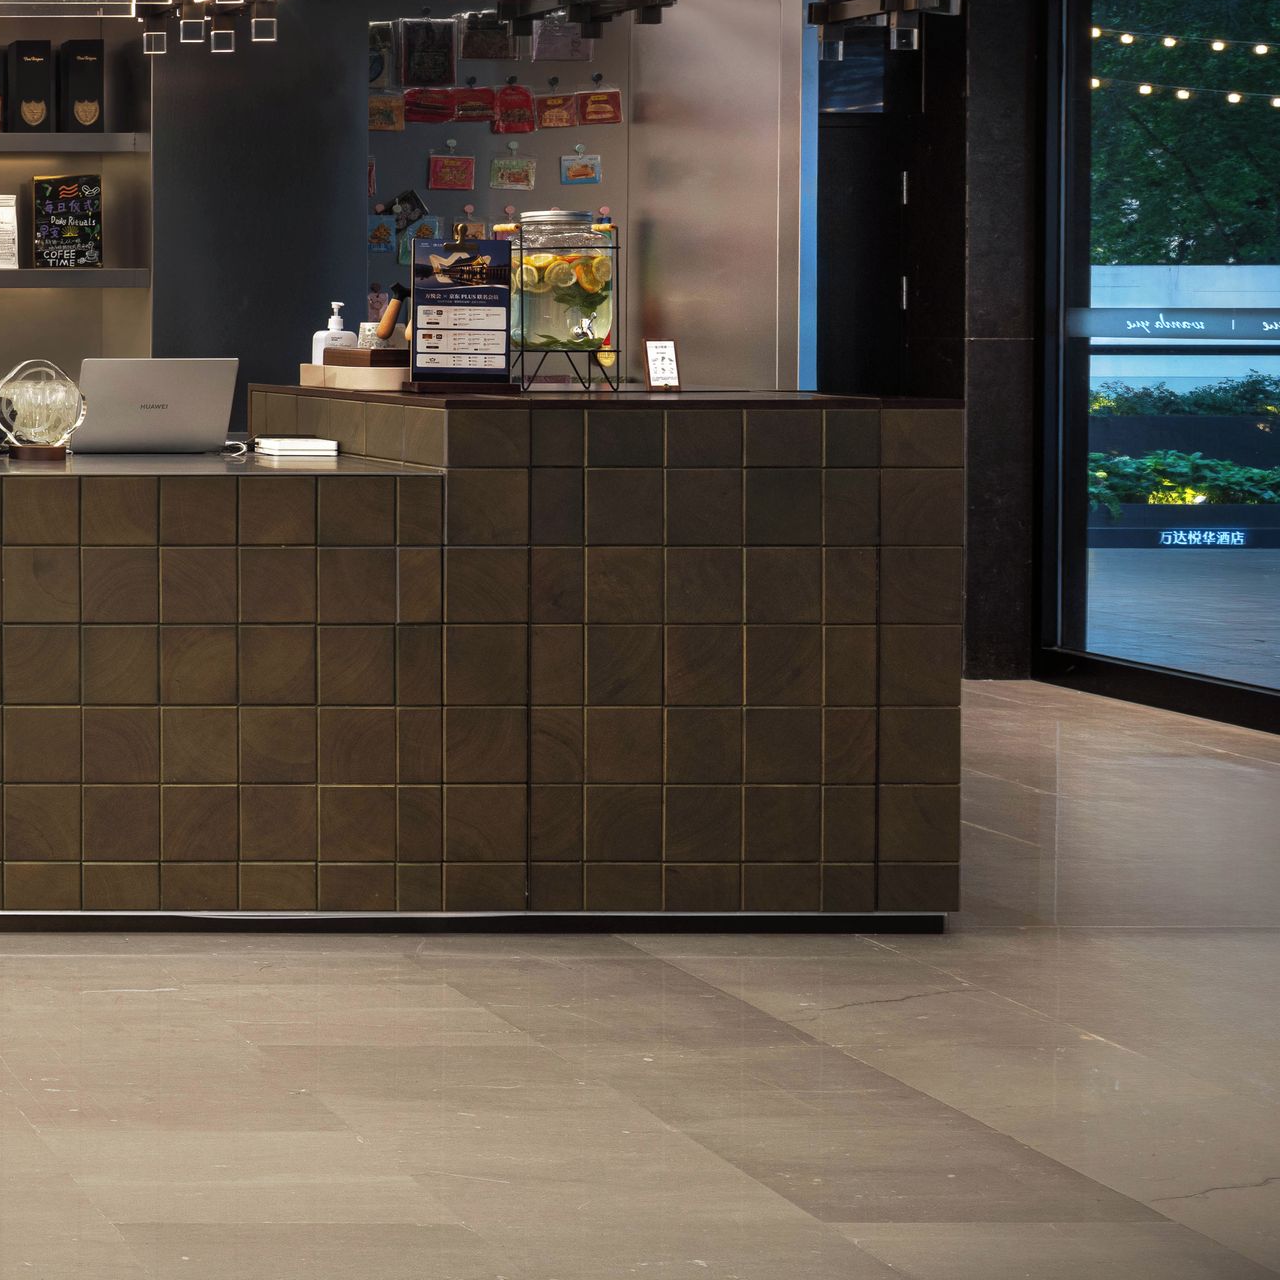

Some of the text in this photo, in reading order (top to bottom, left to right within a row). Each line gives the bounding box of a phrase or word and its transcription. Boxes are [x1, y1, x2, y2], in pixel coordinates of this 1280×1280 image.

[43, 250, 76, 259] COFEE
[47, 259, 75, 267] TIME
[1159, 531, 1246, 545] 万达悦华酒店
